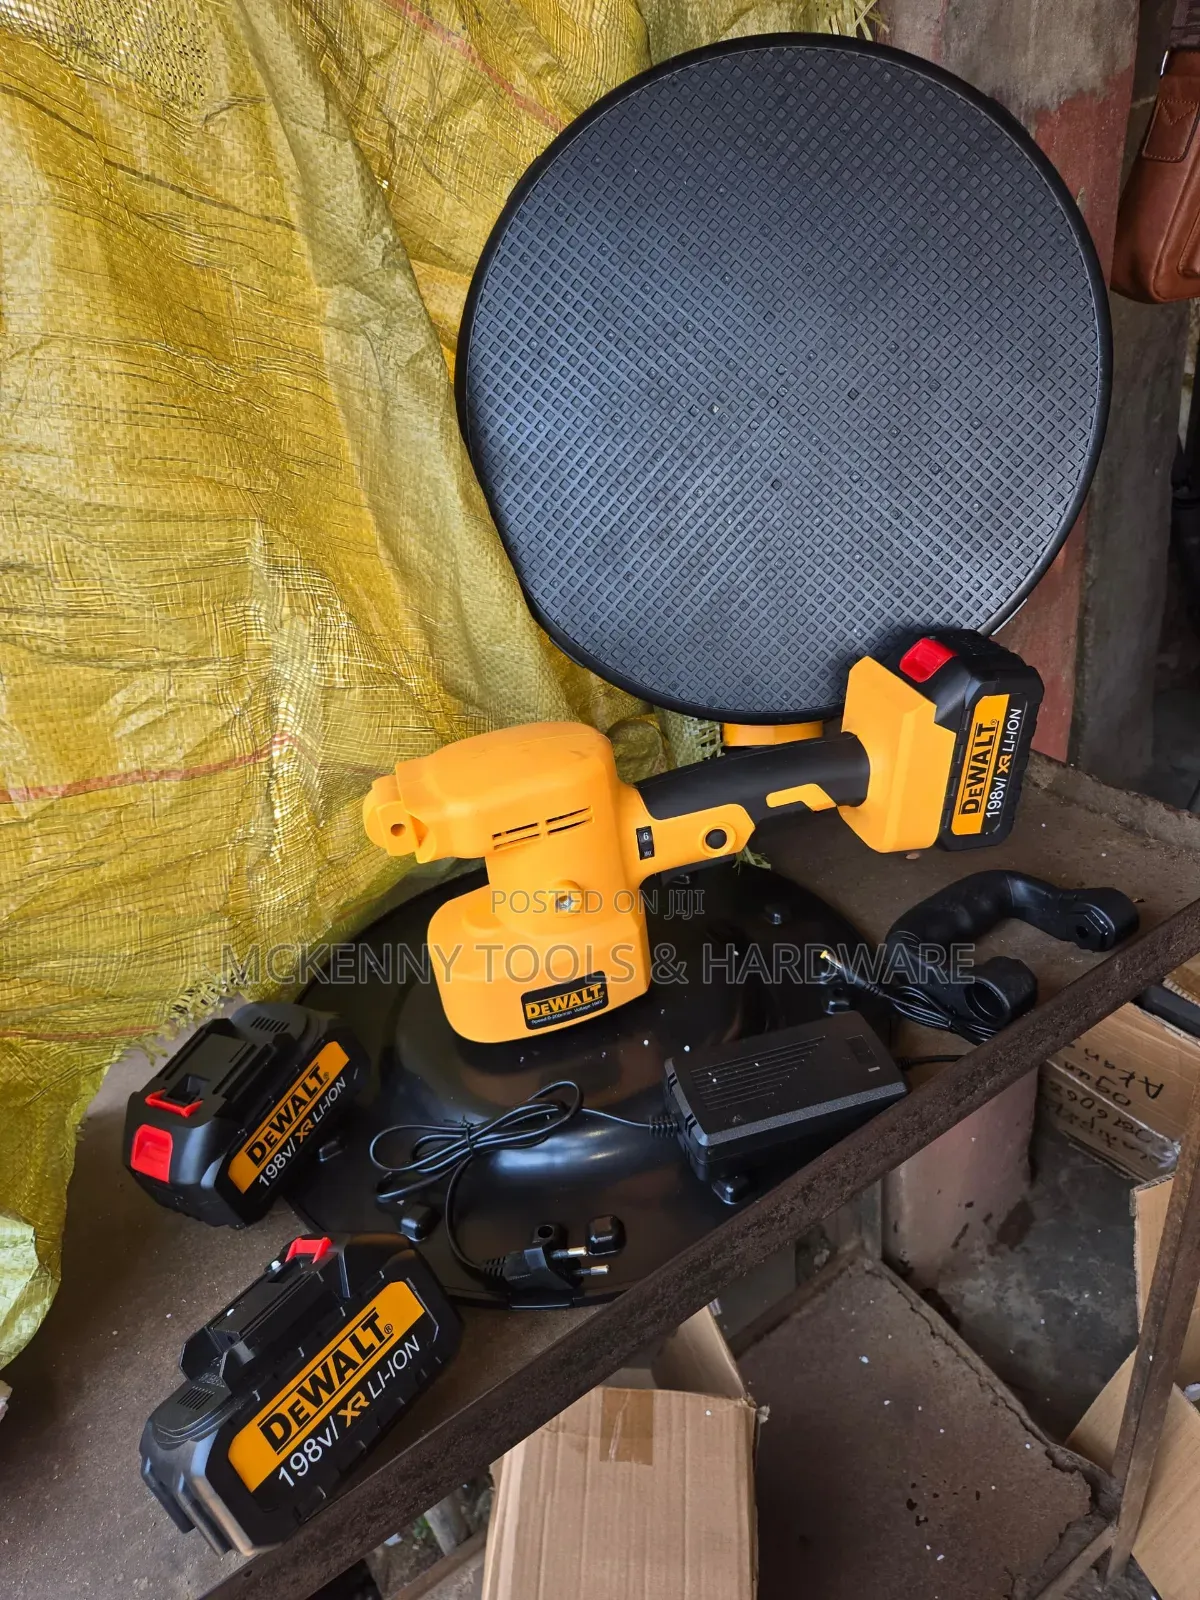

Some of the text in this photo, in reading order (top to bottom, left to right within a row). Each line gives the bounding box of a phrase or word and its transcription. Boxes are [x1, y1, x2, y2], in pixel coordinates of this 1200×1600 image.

[1002, 708, 1022, 752] LI-ION
[643, 832, 650, 841] 6
[312, 1076, 347, 1123] LI-ION
[337, 1390, 371, 1429] XR
[367, 1334, 421, 1400] LI-ION
